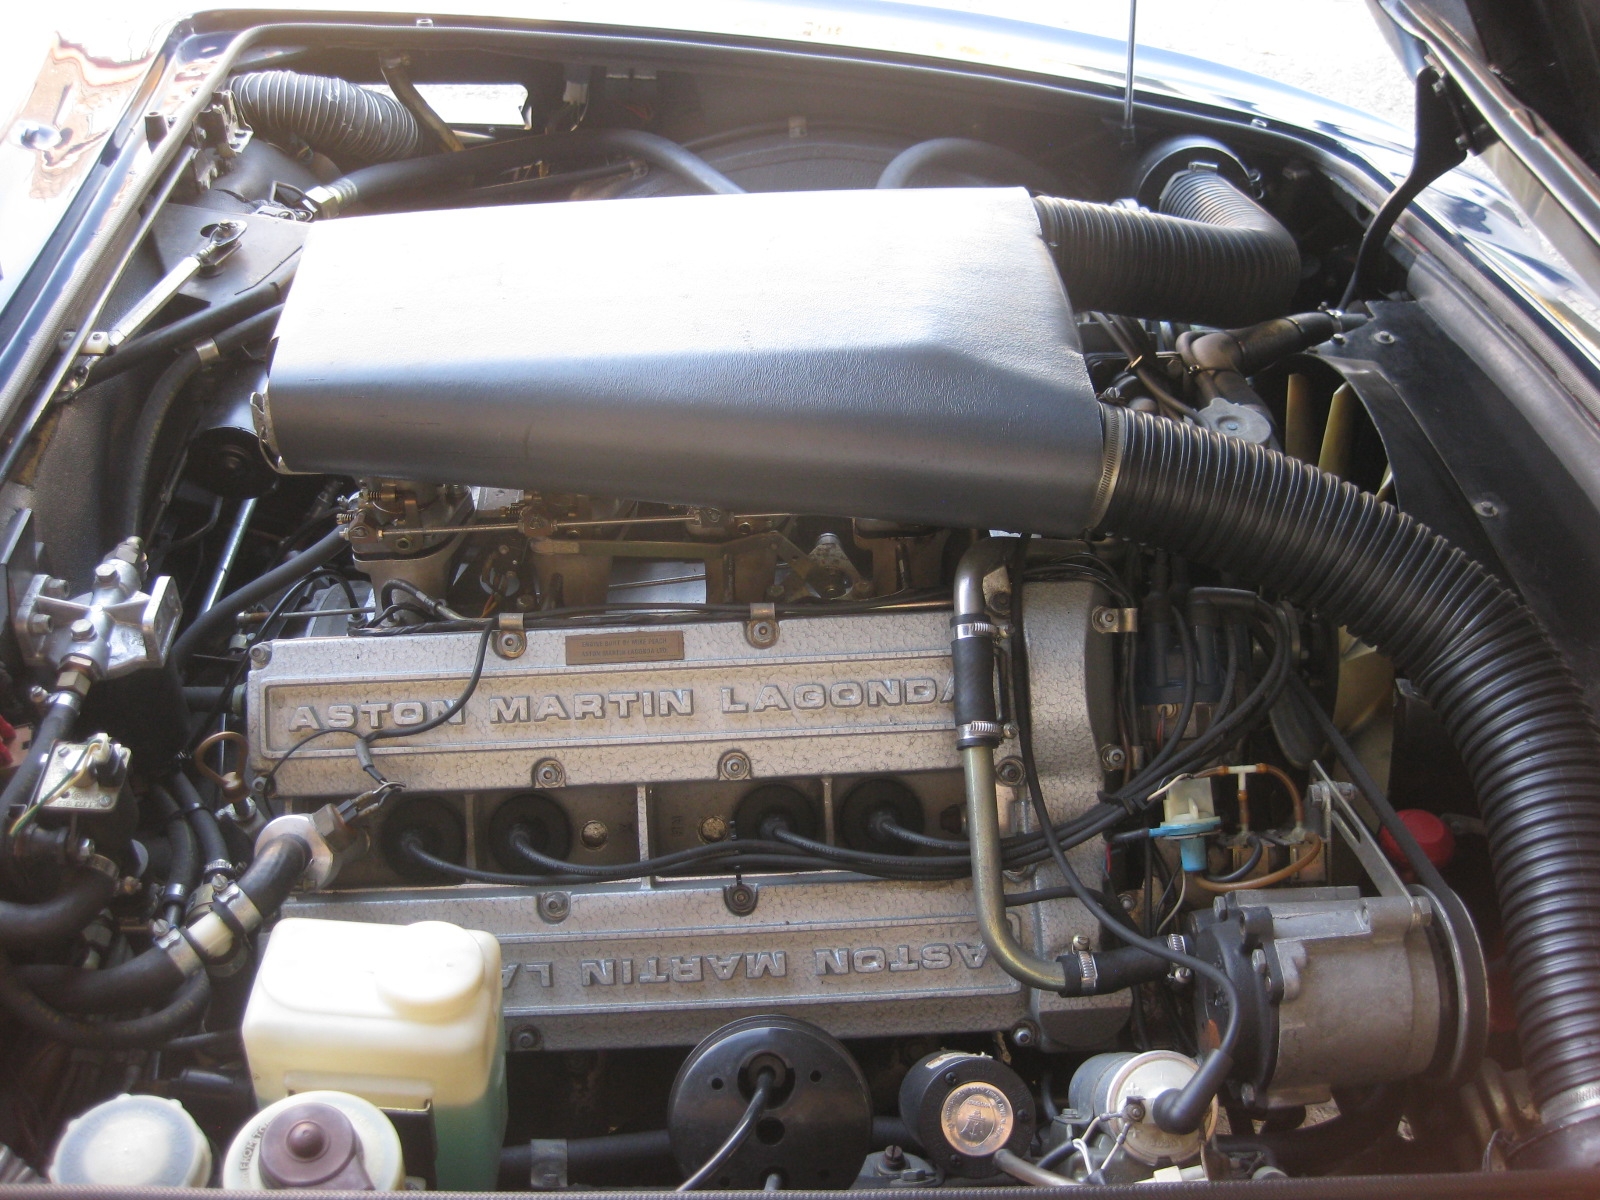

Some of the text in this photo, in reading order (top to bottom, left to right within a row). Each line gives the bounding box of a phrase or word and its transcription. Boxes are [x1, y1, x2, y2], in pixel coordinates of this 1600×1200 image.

[289, 700, 466, 732] ASTON
[490, 690, 694, 724] MARTIN
[581, 950, 786, 987] MARTIN
[813, 941, 989, 976] ASTON
